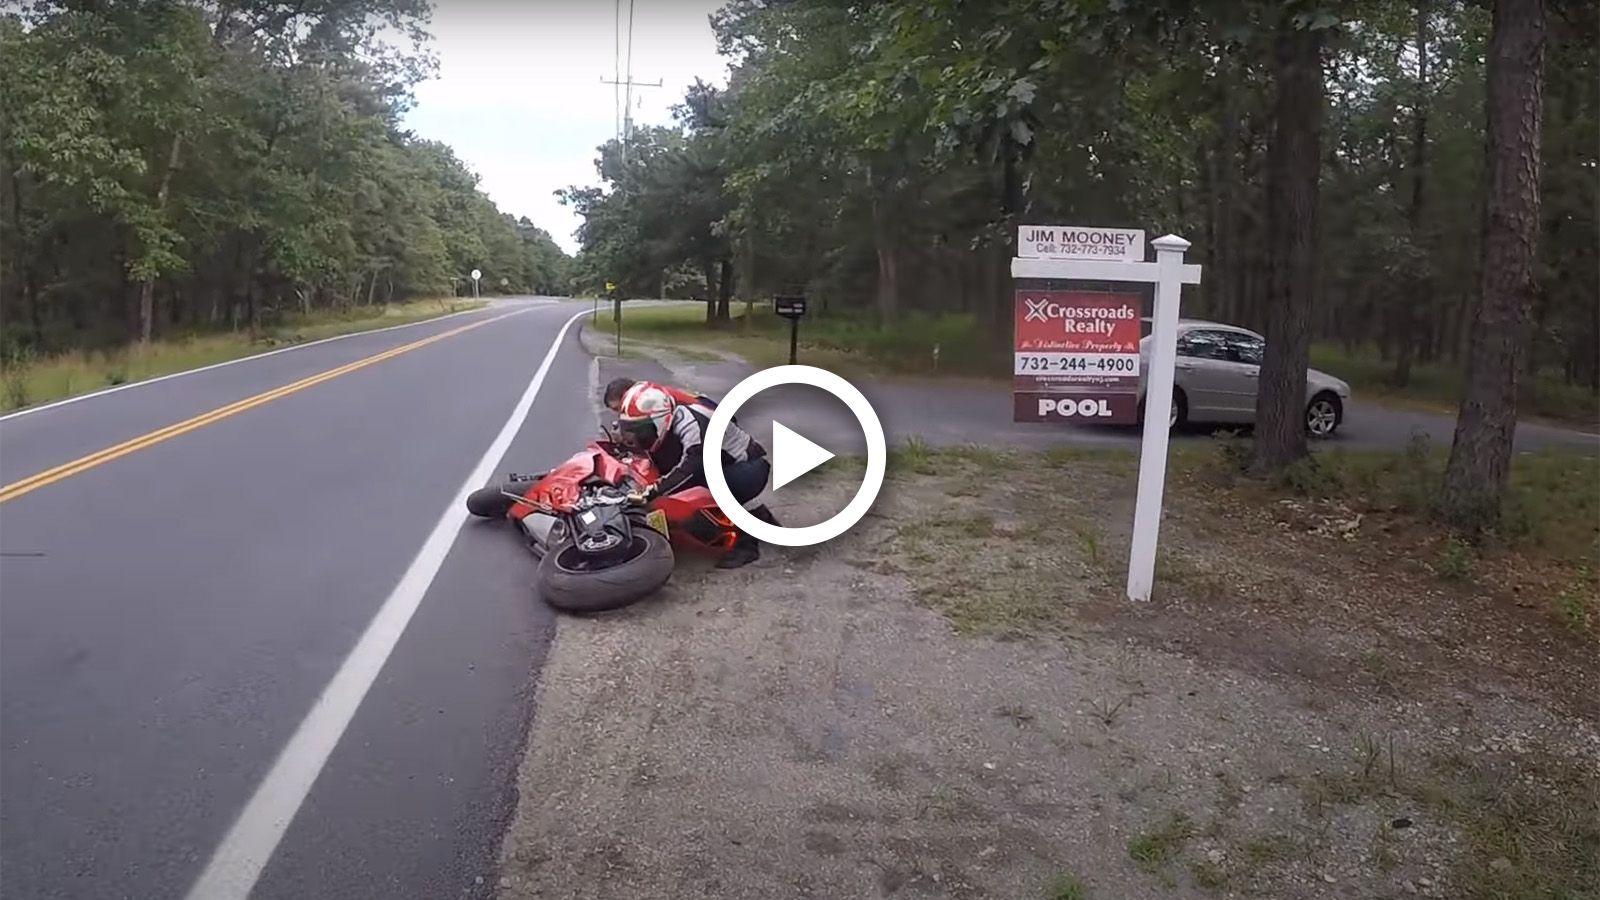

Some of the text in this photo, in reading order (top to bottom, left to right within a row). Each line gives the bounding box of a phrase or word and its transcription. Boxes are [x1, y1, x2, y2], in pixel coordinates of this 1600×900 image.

[1026, 230, 1136, 245] JIM MOONEY
[1046, 303, 1135, 319] Crossroads
[1065, 319, 1115, 337] Realty
[1021, 357, 1134, 371] 732-244-4900
[1038, 398, 1112, 417] POOL
